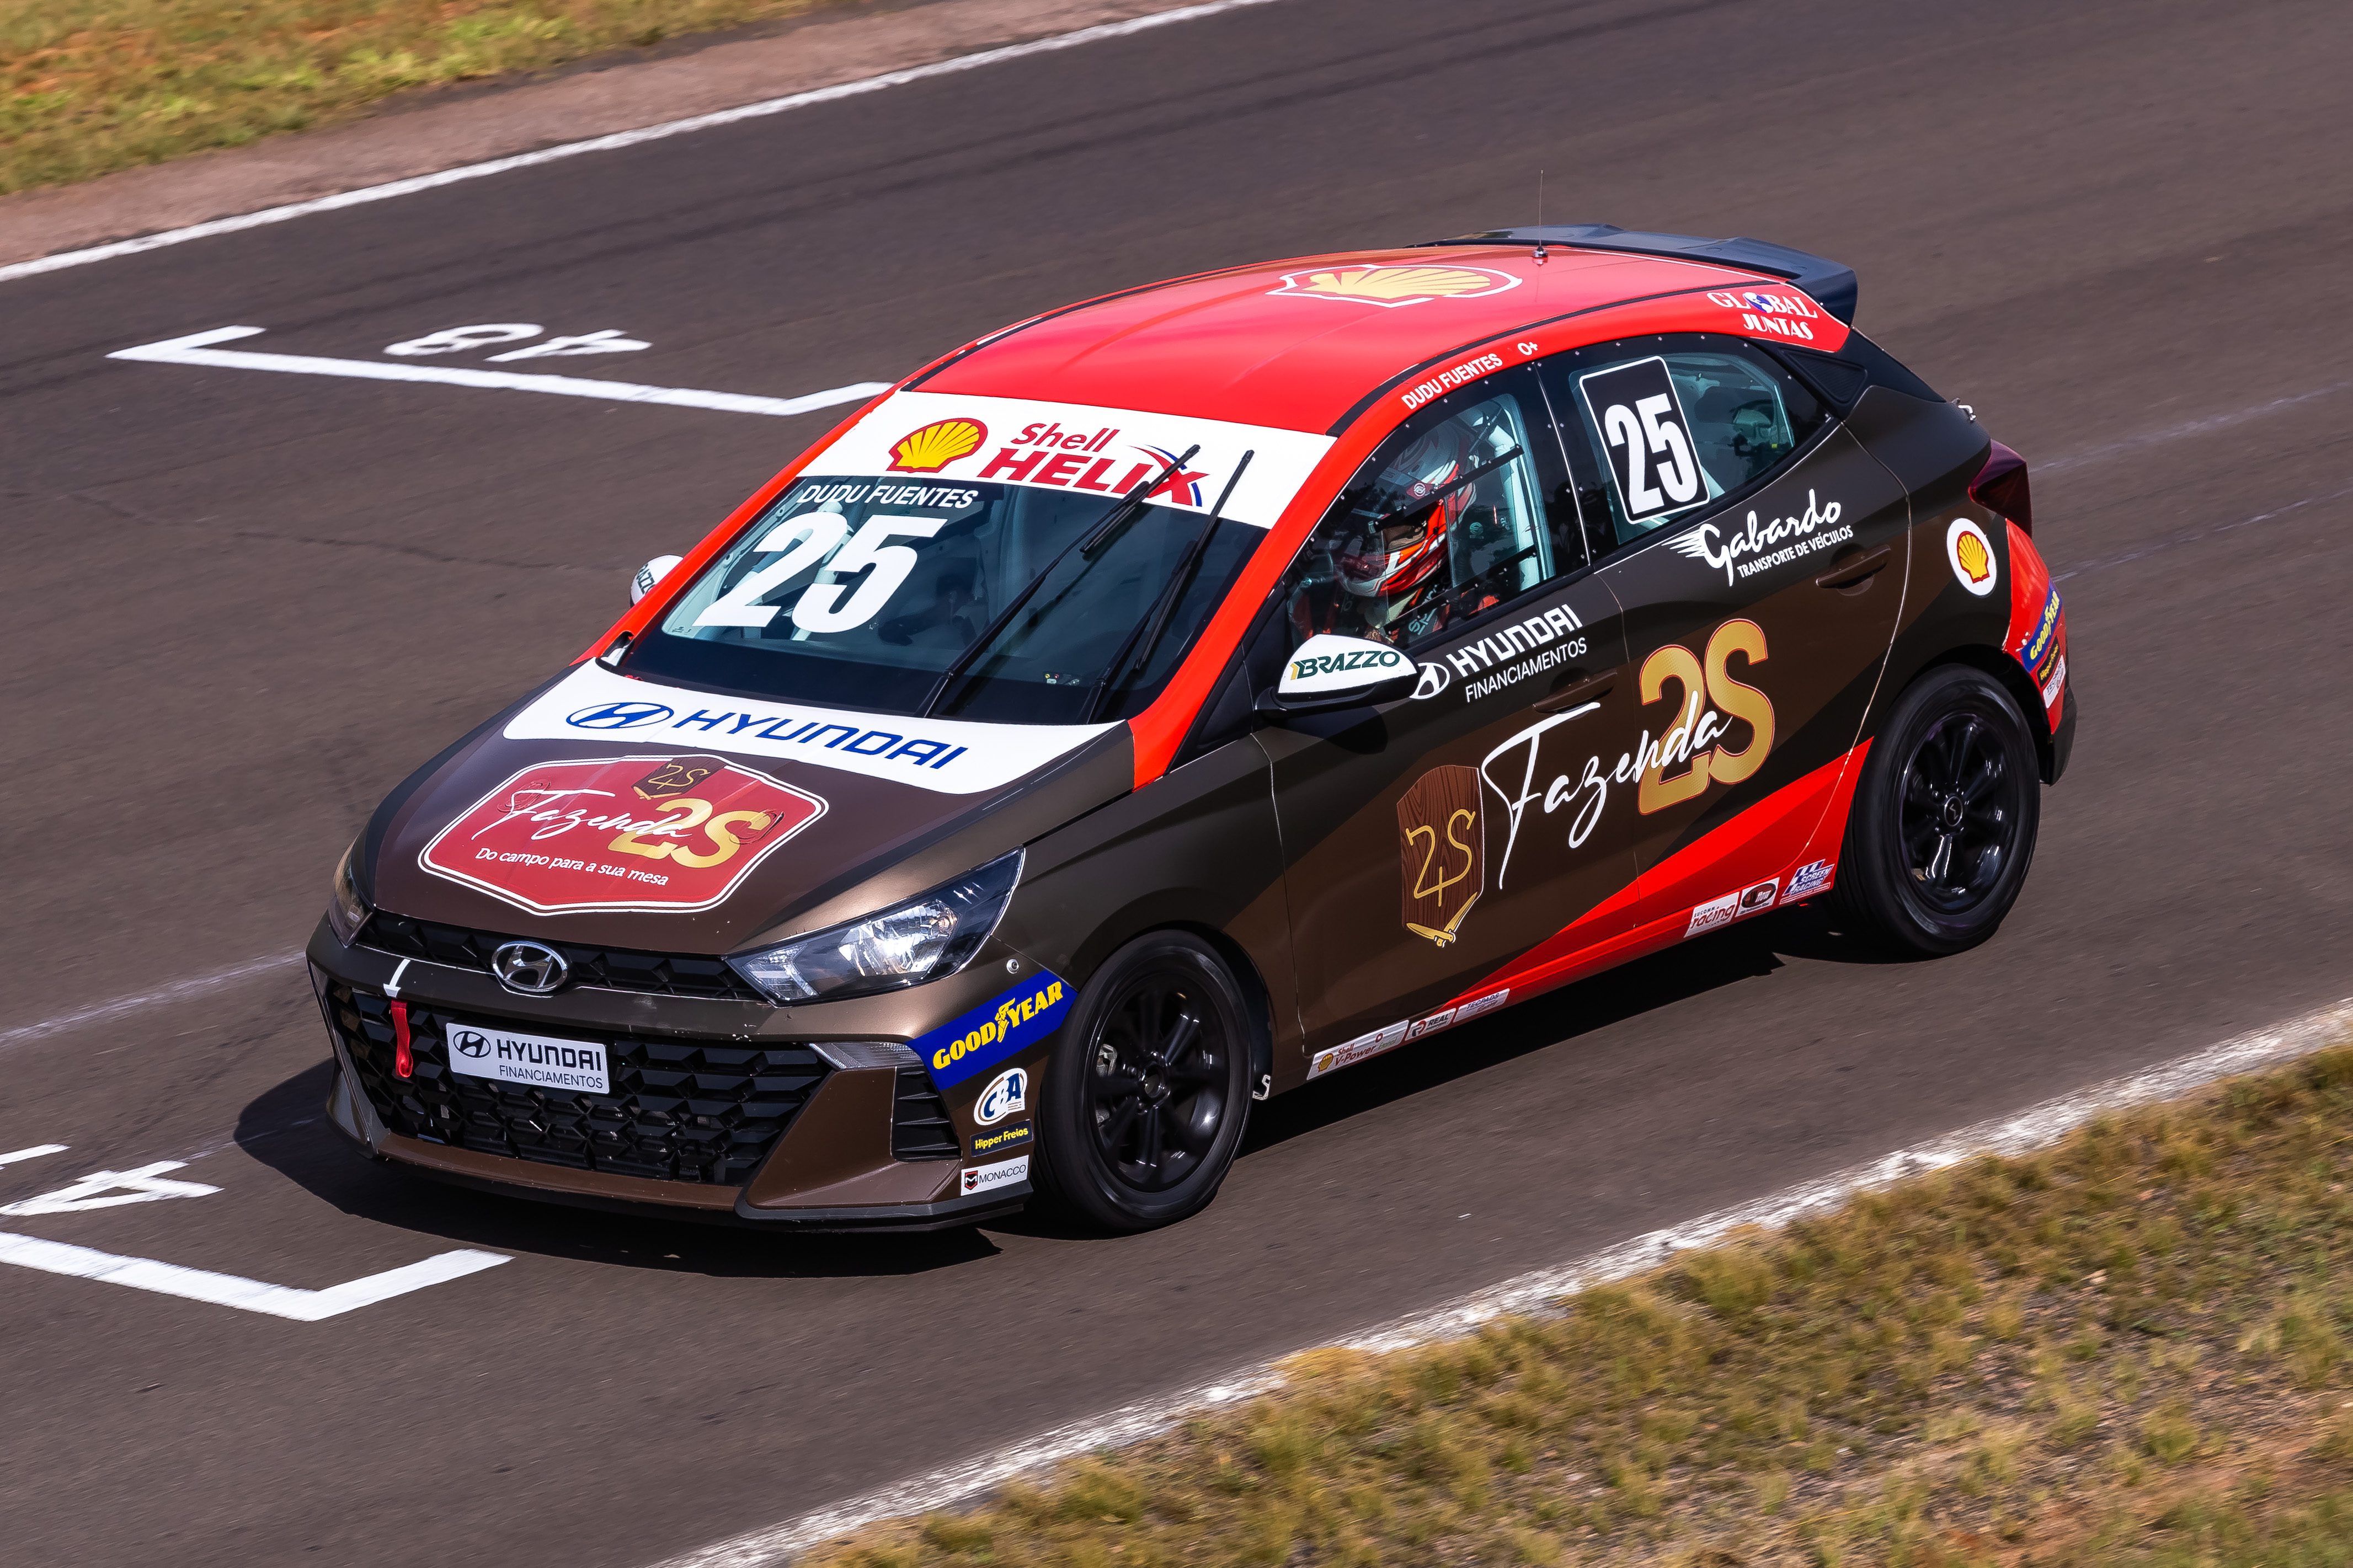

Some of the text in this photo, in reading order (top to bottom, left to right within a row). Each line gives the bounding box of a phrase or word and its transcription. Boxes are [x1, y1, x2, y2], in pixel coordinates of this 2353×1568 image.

[1706, 291, 1818, 319] GLOBAL
[1742, 313, 1814, 340] JUNTAS
[1401, 353, 1503, 410] DUDU FUENTES
[1010, 422, 1121, 452] Shell
[1604, 393, 1698, 514] 25
[977, 445, 1210, 506] HELIX
[796, 484, 978, 509] DUDU FUENTES
[1699, 488, 1842, 587] Gabardo
[1737, 525, 1854, 578] TRANSPORTE DE VEÍCULOS
[691, 511, 948, 634] 25
[1446, 604, 1583, 677] HYUNDAI
[1290, 650, 1400, 681] BRAZZO
[1465, 638, 1587, 703] FINANCIAMENTOS
[671, 709, 969, 769] HYUNDAI
[1481, 618, 1775, 890] Fazenda 2S
[471, 788, 772, 869] Fazenda 2S
[475, 847, 669, 887] Do campo para a sua mesa
[1801, 869, 1829, 883] SCREEN
[1794, 878, 1824, 895] RACING
[1690, 904, 1736, 929] racing
[932, 981, 1064, 1069] GOODYEAR
[1427, 1014, 1449, 1027] REAL
[497, 1037, 602, 1072] HYUNDAI
[1334, 1045, 1376, 1066] V-Power
[1337, 1043, 1355, 1055] Shell
[499, 1064, 604, 1090] FINANCIAMENTOS
[984, 1073, 1022, 1119] CBA
[975, 1127, 1028, 1149] Hipper Freios
[979, 1164, 1027, 1184] MONACCO
